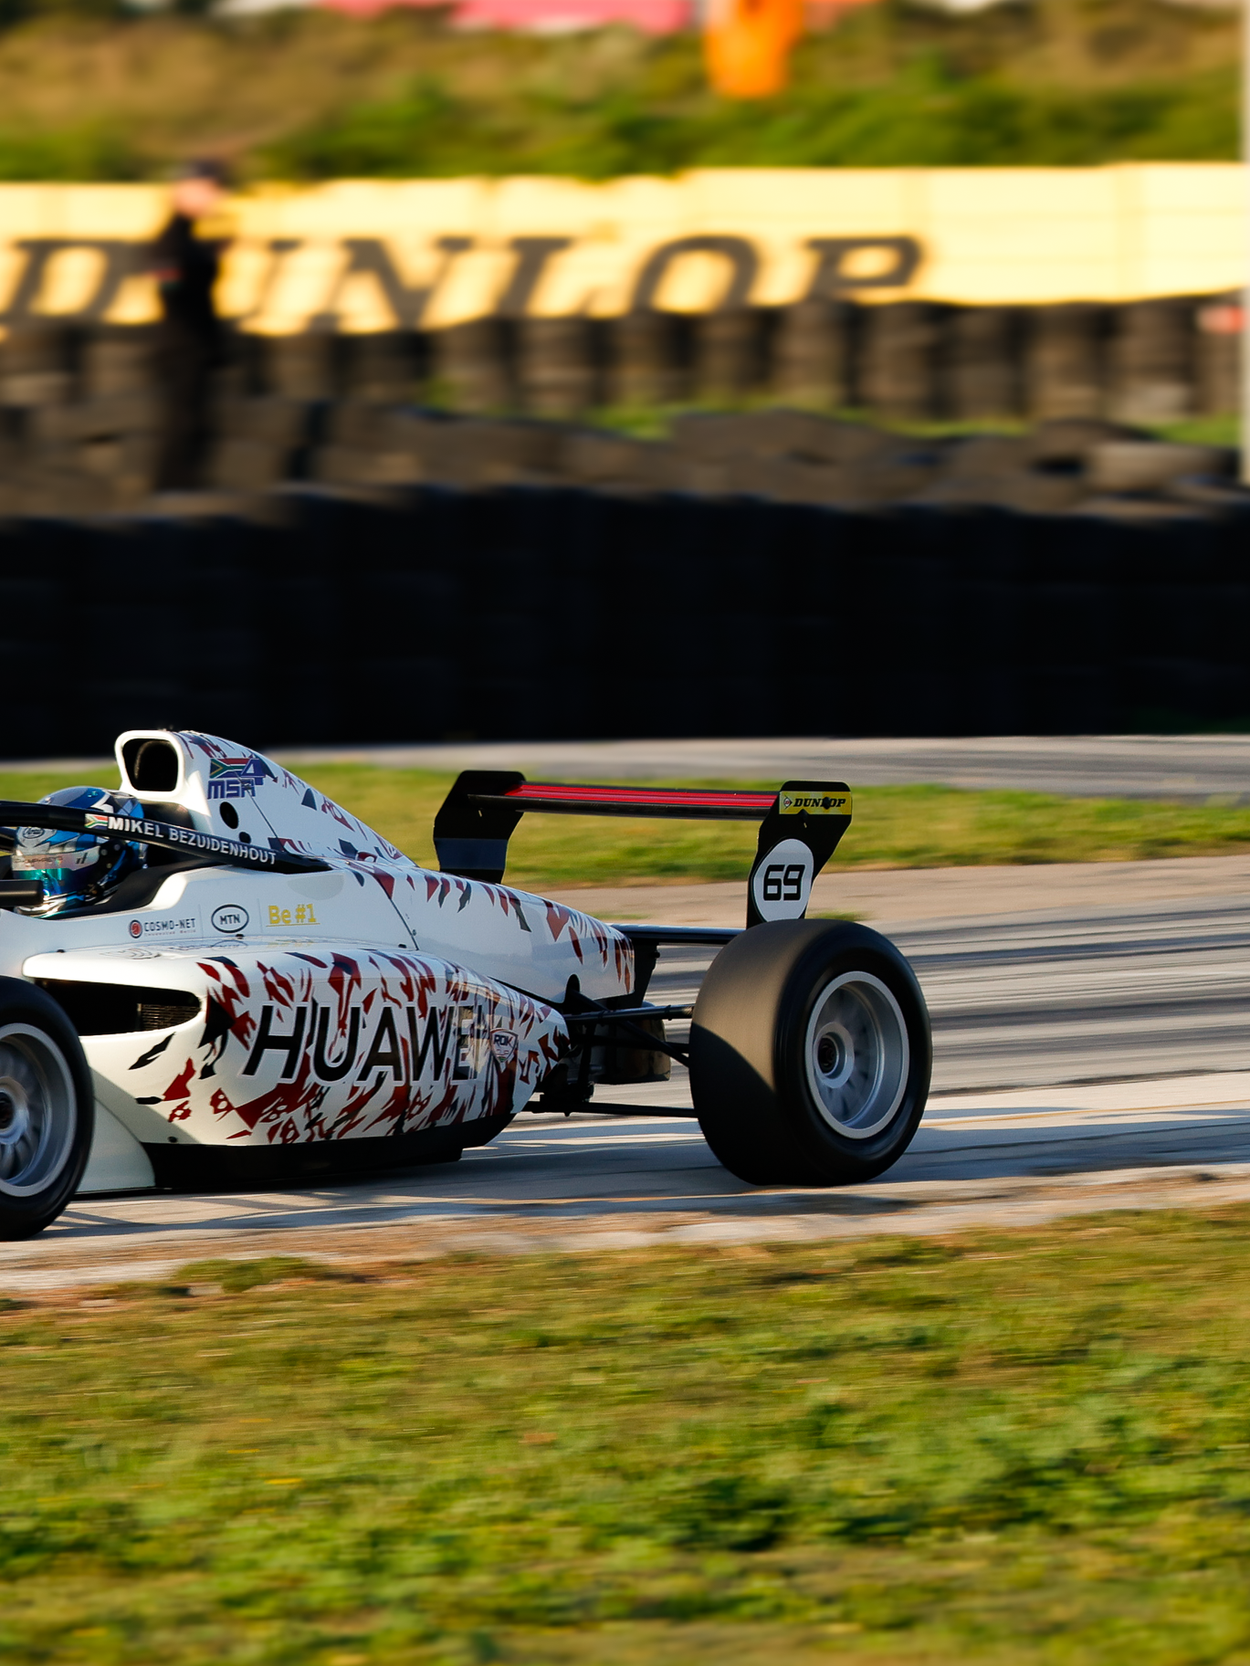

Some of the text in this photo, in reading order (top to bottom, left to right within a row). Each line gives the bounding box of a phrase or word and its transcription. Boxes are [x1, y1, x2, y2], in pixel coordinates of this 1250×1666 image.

[108, 816, 277, 865] MIKEL BEZUIDENHOUT
[763, 865, 805, 901] 69
[143, 918, 196, 933] COSMO-NET
[219, 914, 241, 925] MTN
[268, 903, 317, 925] Be #1
[241, 1004, 483, 1083] HUAWEI
